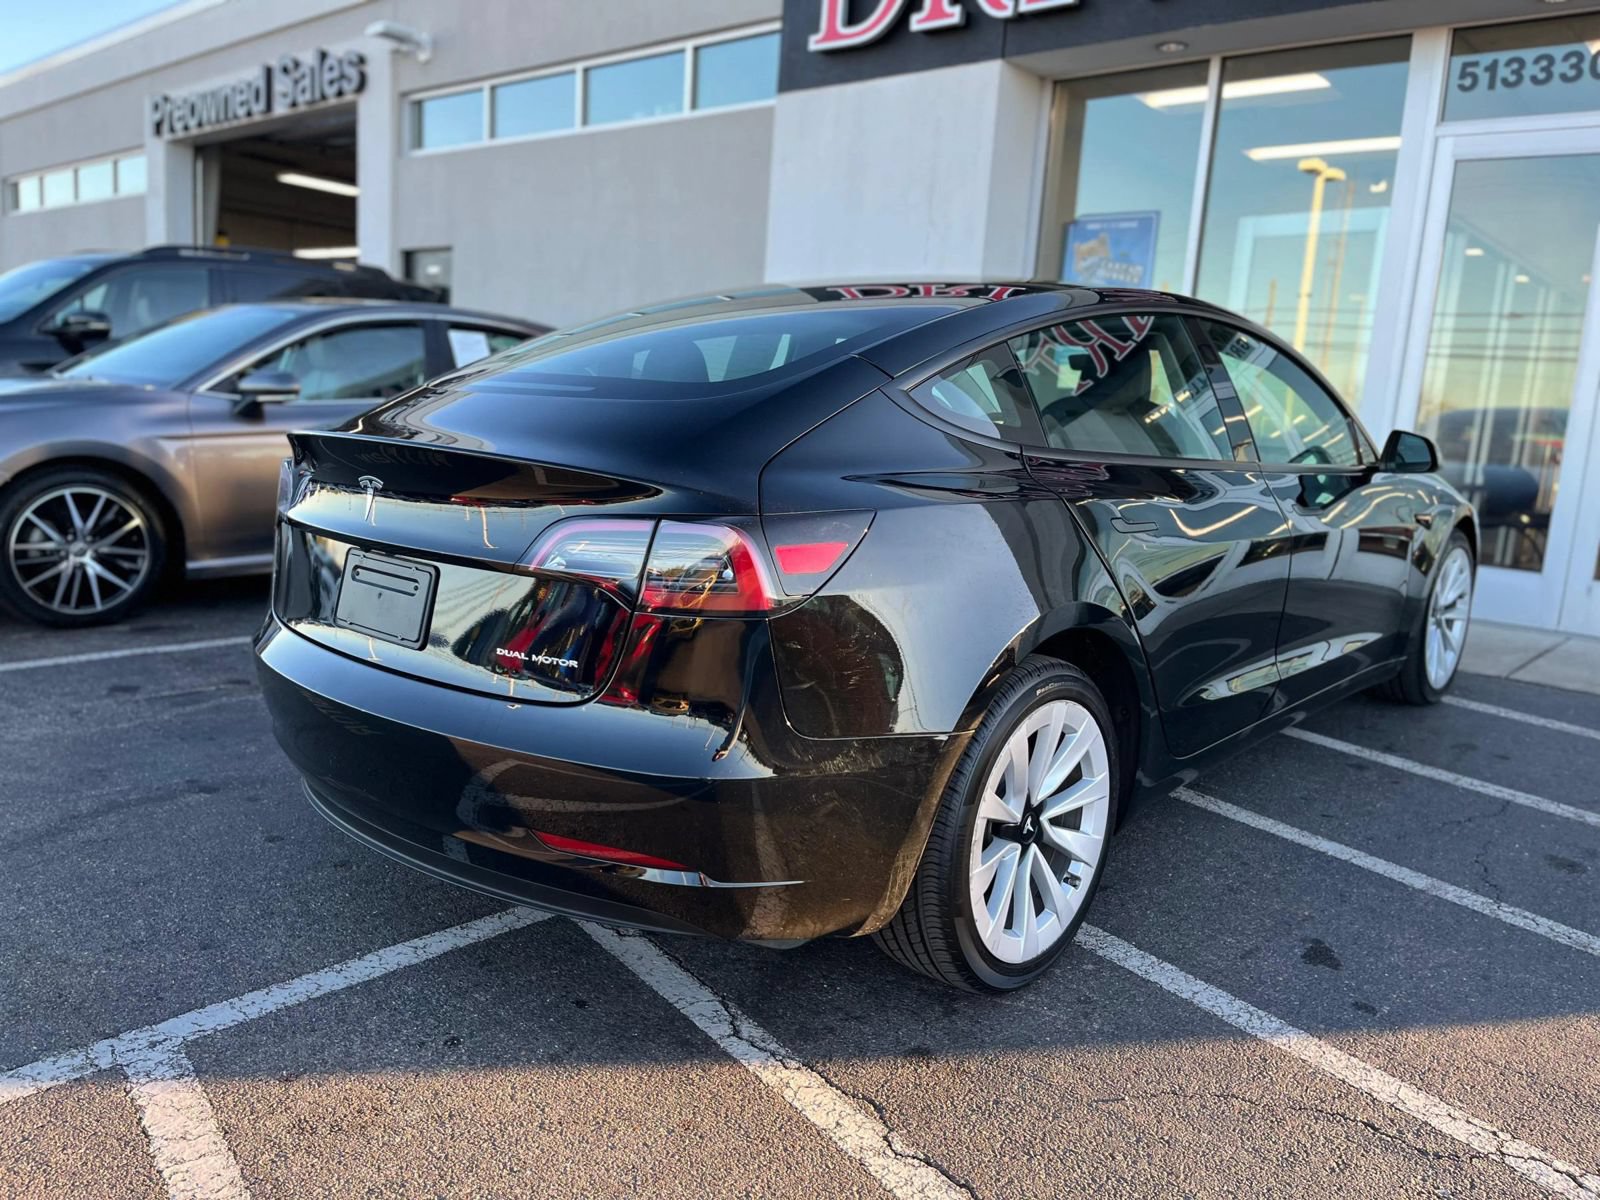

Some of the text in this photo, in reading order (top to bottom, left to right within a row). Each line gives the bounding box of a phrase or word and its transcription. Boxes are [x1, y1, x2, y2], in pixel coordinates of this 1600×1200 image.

[152, 48, 367, 137] Preowned Sales
[496, 647, 578, 668] DUAL MOTOR
